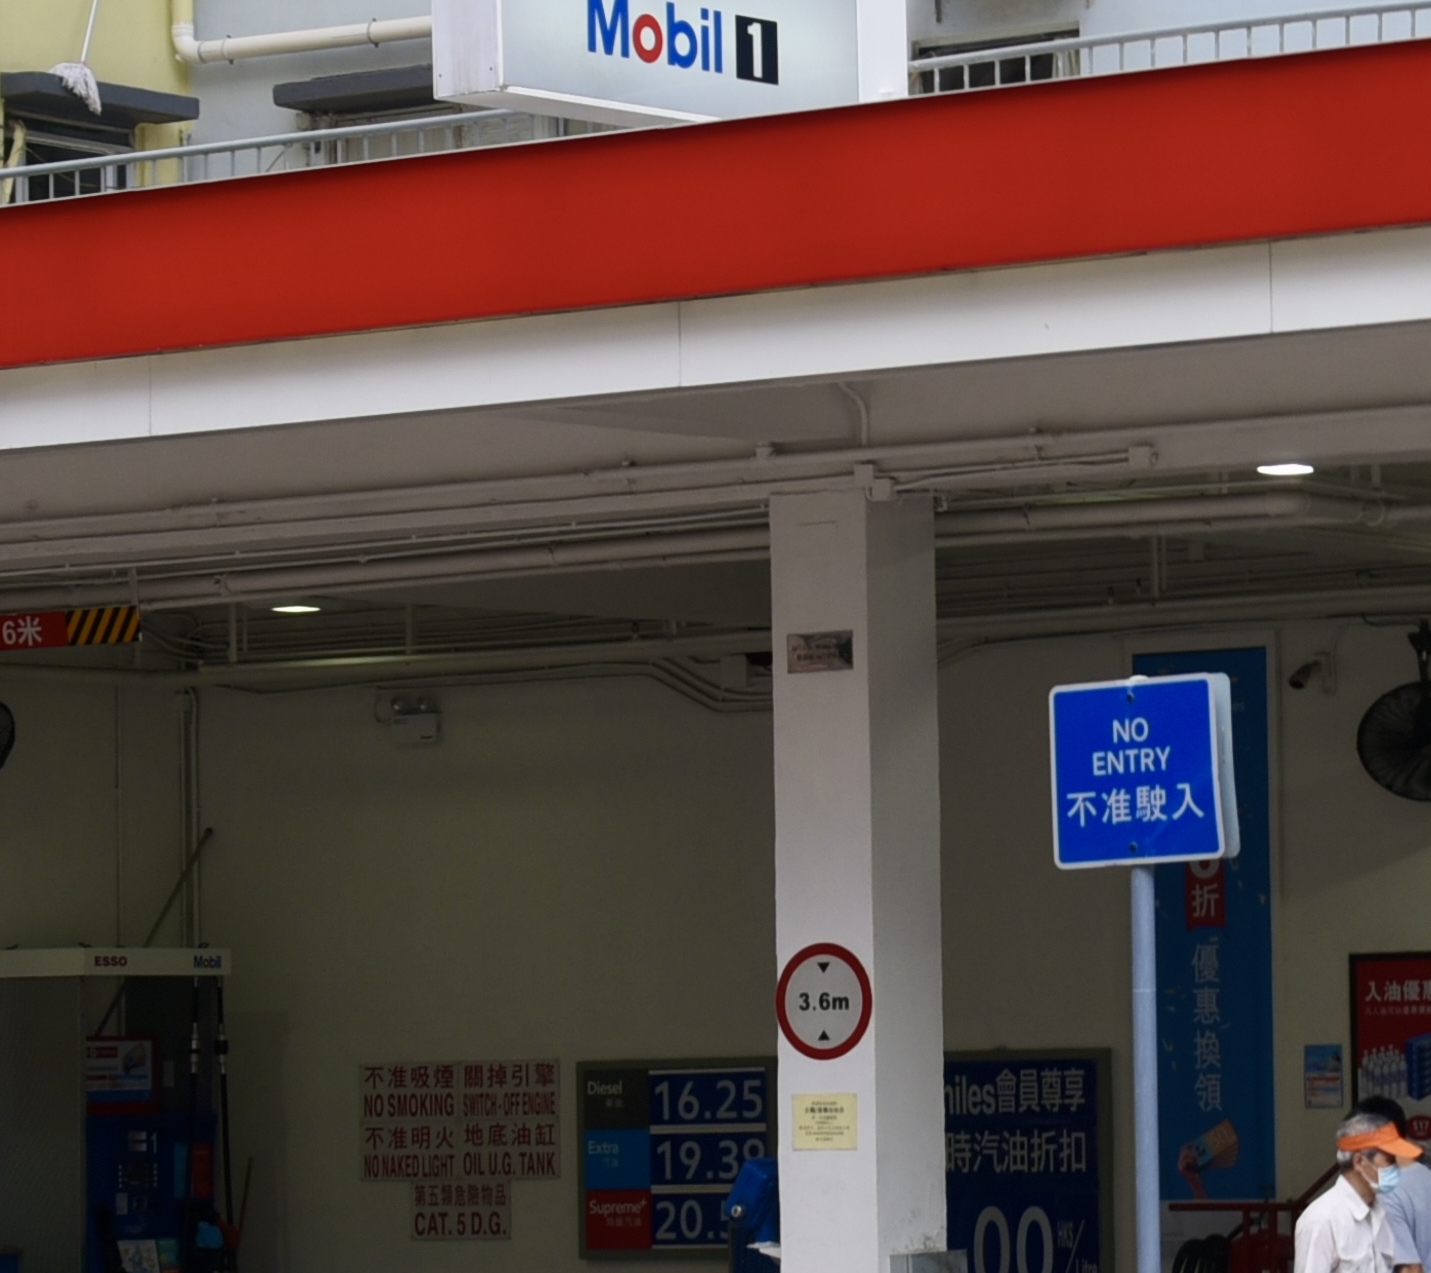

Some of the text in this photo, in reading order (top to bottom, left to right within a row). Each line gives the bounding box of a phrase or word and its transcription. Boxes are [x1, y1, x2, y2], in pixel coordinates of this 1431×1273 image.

[1112, 717, 1150, 745] NO
[1092, 746, 1172, 777] ENTRY
[1066, 782, 1206, 828] 不准駛入
[94, 955, 223, 969] ESSO Mobil
[798, 991, 851, 1013] 3.6m
[364, 1064, 455, 1090] 不准吸煙
[464, 1063, 556, 1088] 關掉引擎
[522, 1091, 556, 1116] ENGINE
[587, 1079, 764, 1121] Diesel 16.25
[944, 1067, 1087, 1116] iles會員尊享
[363, 1092, 455, 1118] NO SMOKING
[364, 1126, 455, 1150] 不准明火
[464, 1122, 556, 1147] 地底油缸
[587, 1140, 619, 1155] Extra
[364, 1154, 455, 1178] NO NAKED LIGHT
[463, 1152, 556, 1176] OIL U.G. TANK
[414, 1211, 507, 1236] CAT. 5 D.G.
